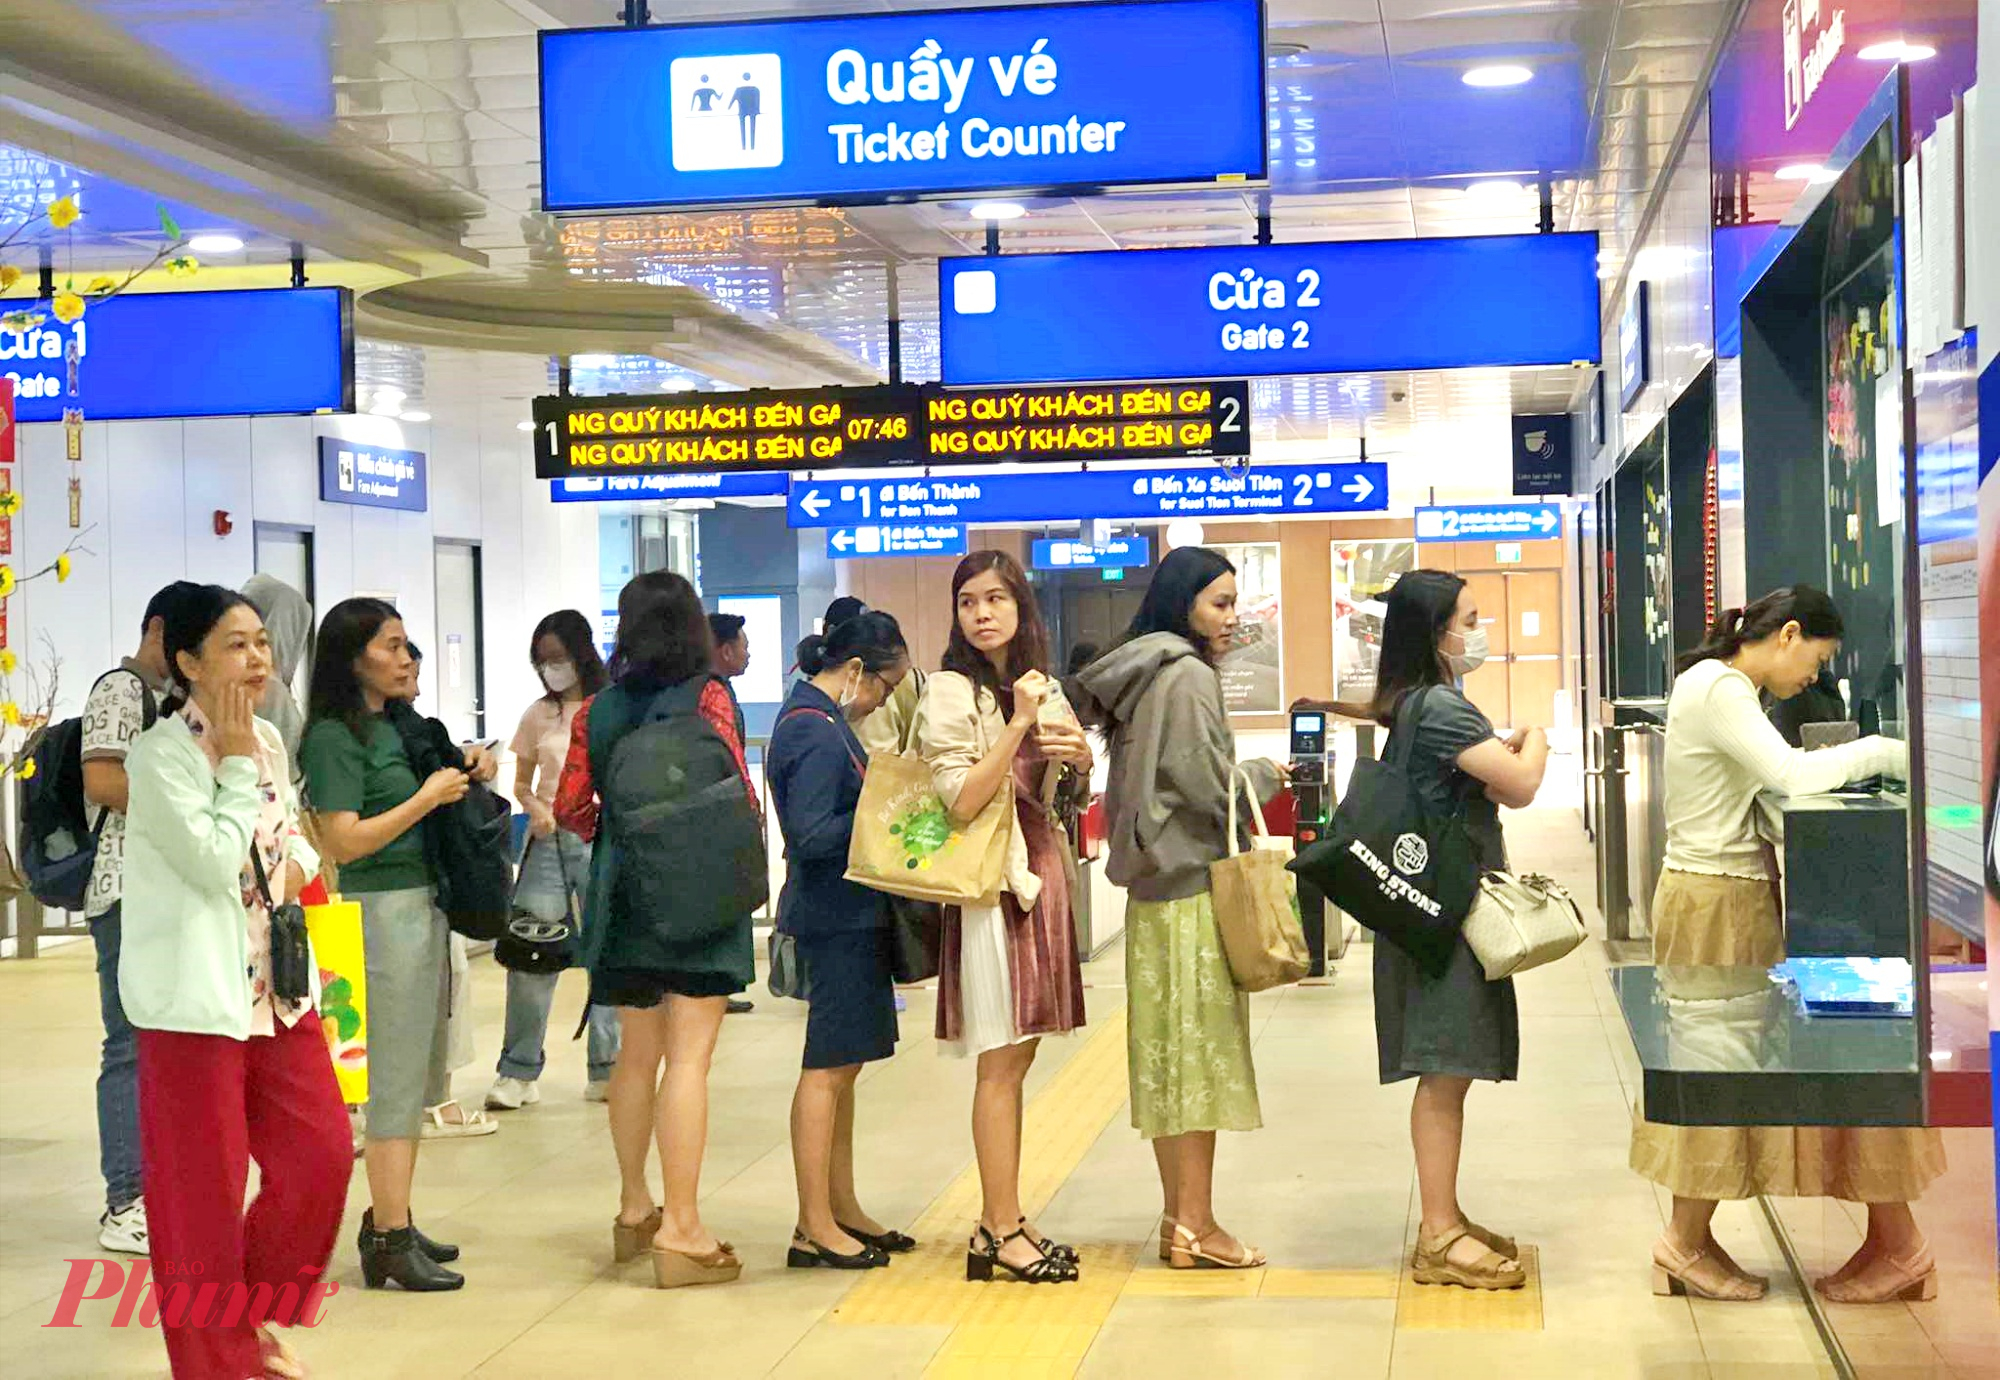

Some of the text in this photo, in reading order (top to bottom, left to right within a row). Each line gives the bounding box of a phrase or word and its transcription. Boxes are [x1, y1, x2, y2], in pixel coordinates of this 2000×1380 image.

[826, 38, 1057, 113] Quầy vé
[828, 114, 1126, 164] Ticket Counter
[1208, 266, 1321, 311] Cửa 2
[72, 320, 86, 357] 1
[1221, 321, 1310, 352] Gate 2
[568, 412, 604, 434] NG
[608, 407, 660, 433] QUÝ
[664, 405, 746, 431] KHÁCH
[809, 403, 841, 426] GA
[929, 400, 967, 421] NG
[971, 393, 1024, 420] QUÝ
[1028, 391, 1113, 418] KHÁCH
[1178, 390, 1211, 412] GA
[1219, 397, 1241, 433] 2
[545, 421, 558, 456] 1
[847, 417, 907, 440] 07:46
[930, 431, 968, 453] NG
[973, 426, 1026, 452] QUÝ
[1030, 423, 1114, 450] KHÁCH
[1179, 423, 1212, 445] GA
[570, 444, 606, 466] NG
[610, 438, 662, 465] QUÝ
[666, 436, 748, 463] KHÁCH
[810, 436, 842, 459] GA
[859, 486, 871, 518] 1
[1293, 474, 1313, 506] 2
[881, 527, 890, 551] 1
[1443, 510, 1460, 536] 2
[1349, 839, 1441, 917] KING STONE
